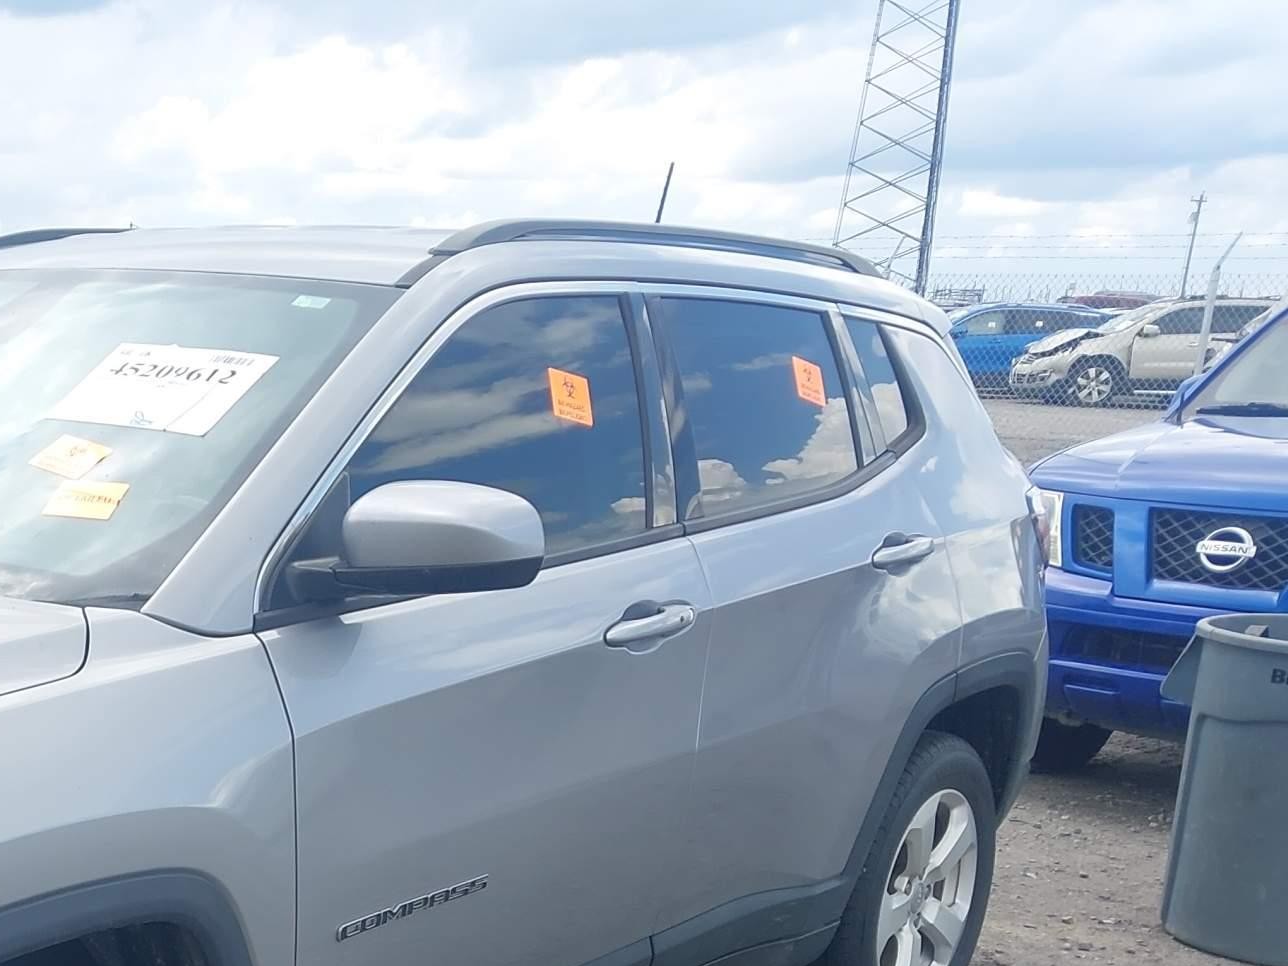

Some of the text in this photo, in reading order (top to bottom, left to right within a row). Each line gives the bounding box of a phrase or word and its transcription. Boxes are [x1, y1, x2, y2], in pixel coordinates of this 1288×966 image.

[108, 361, 238, 385] 45209612
[1200, 543, 1249, 554] NISSAN
[336, 873, 489, 942] COMPASS
